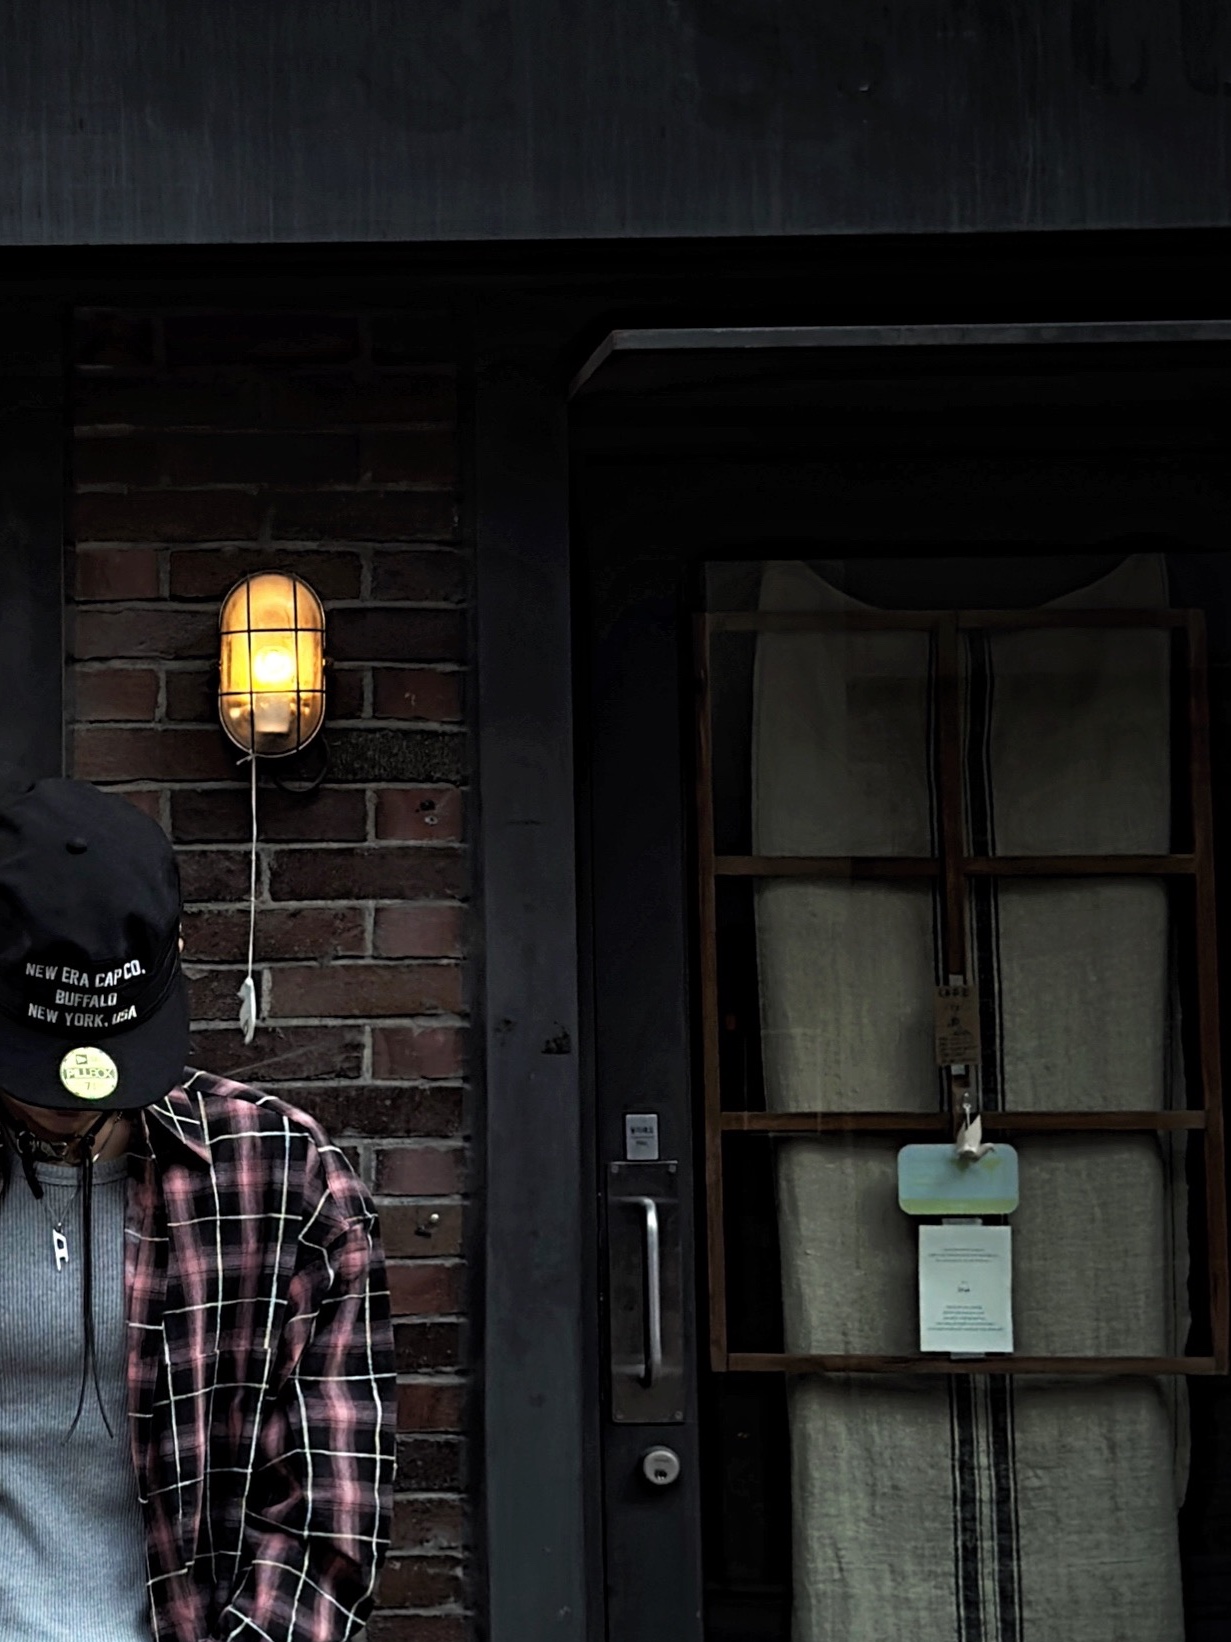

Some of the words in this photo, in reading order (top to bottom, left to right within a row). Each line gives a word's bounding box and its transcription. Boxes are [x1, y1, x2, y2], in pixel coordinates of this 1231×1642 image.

[25, 962, 58, 980] NEW
[61, 966, 90, 988] ERA
[54, 988, 118, 1008] BUFFALO
[28, 1002, 59, 1024] NEW
[111, 1004, 138, 1025] USA
